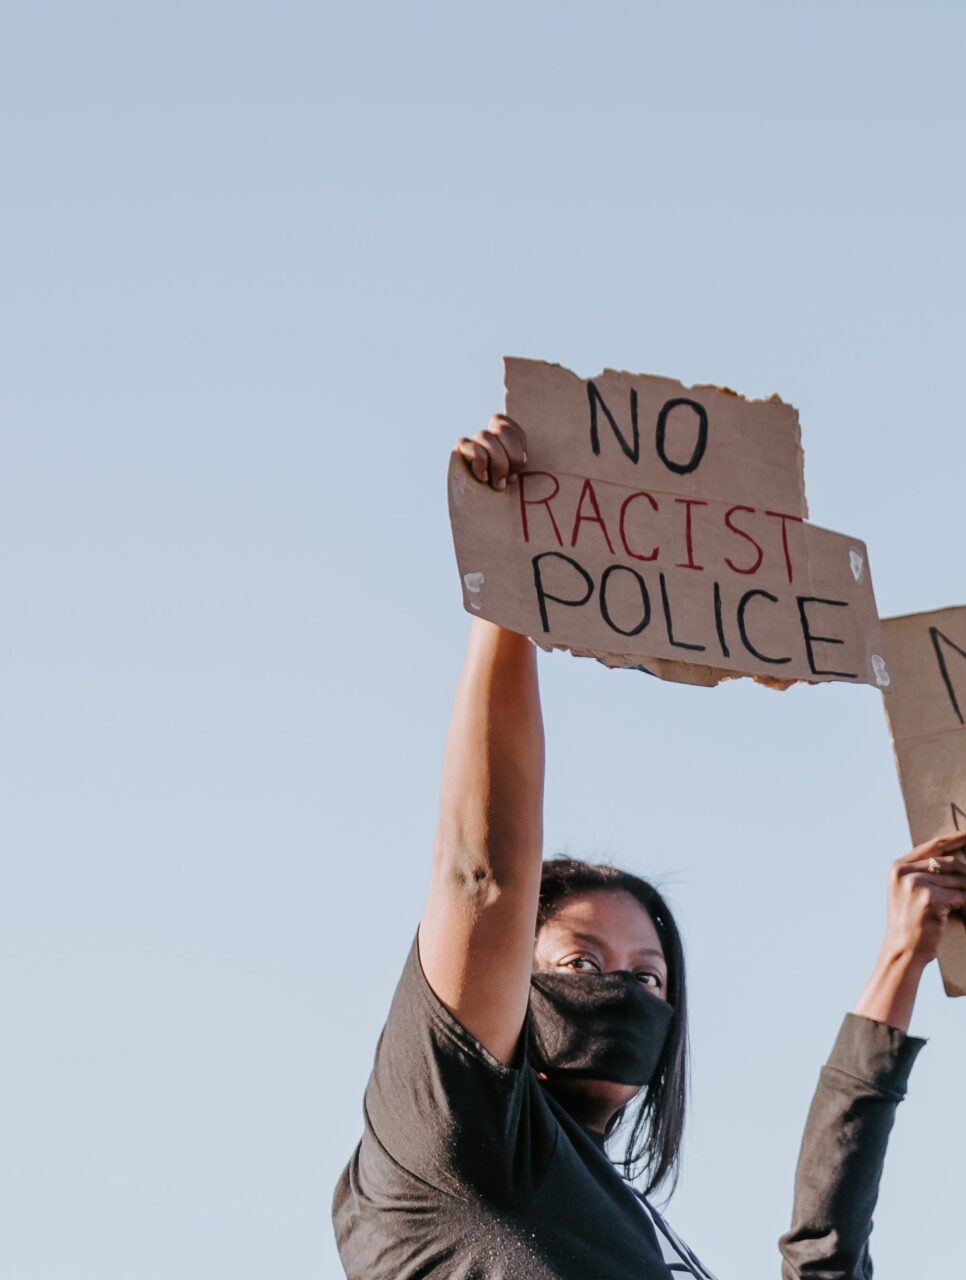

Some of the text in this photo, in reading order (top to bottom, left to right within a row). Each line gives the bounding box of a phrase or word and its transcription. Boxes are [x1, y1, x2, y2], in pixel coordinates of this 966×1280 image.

[586, 380, 709, 475] NO
[516, 470, 804, 583] RACIST
[531, 551, 858, 678] POLICE
